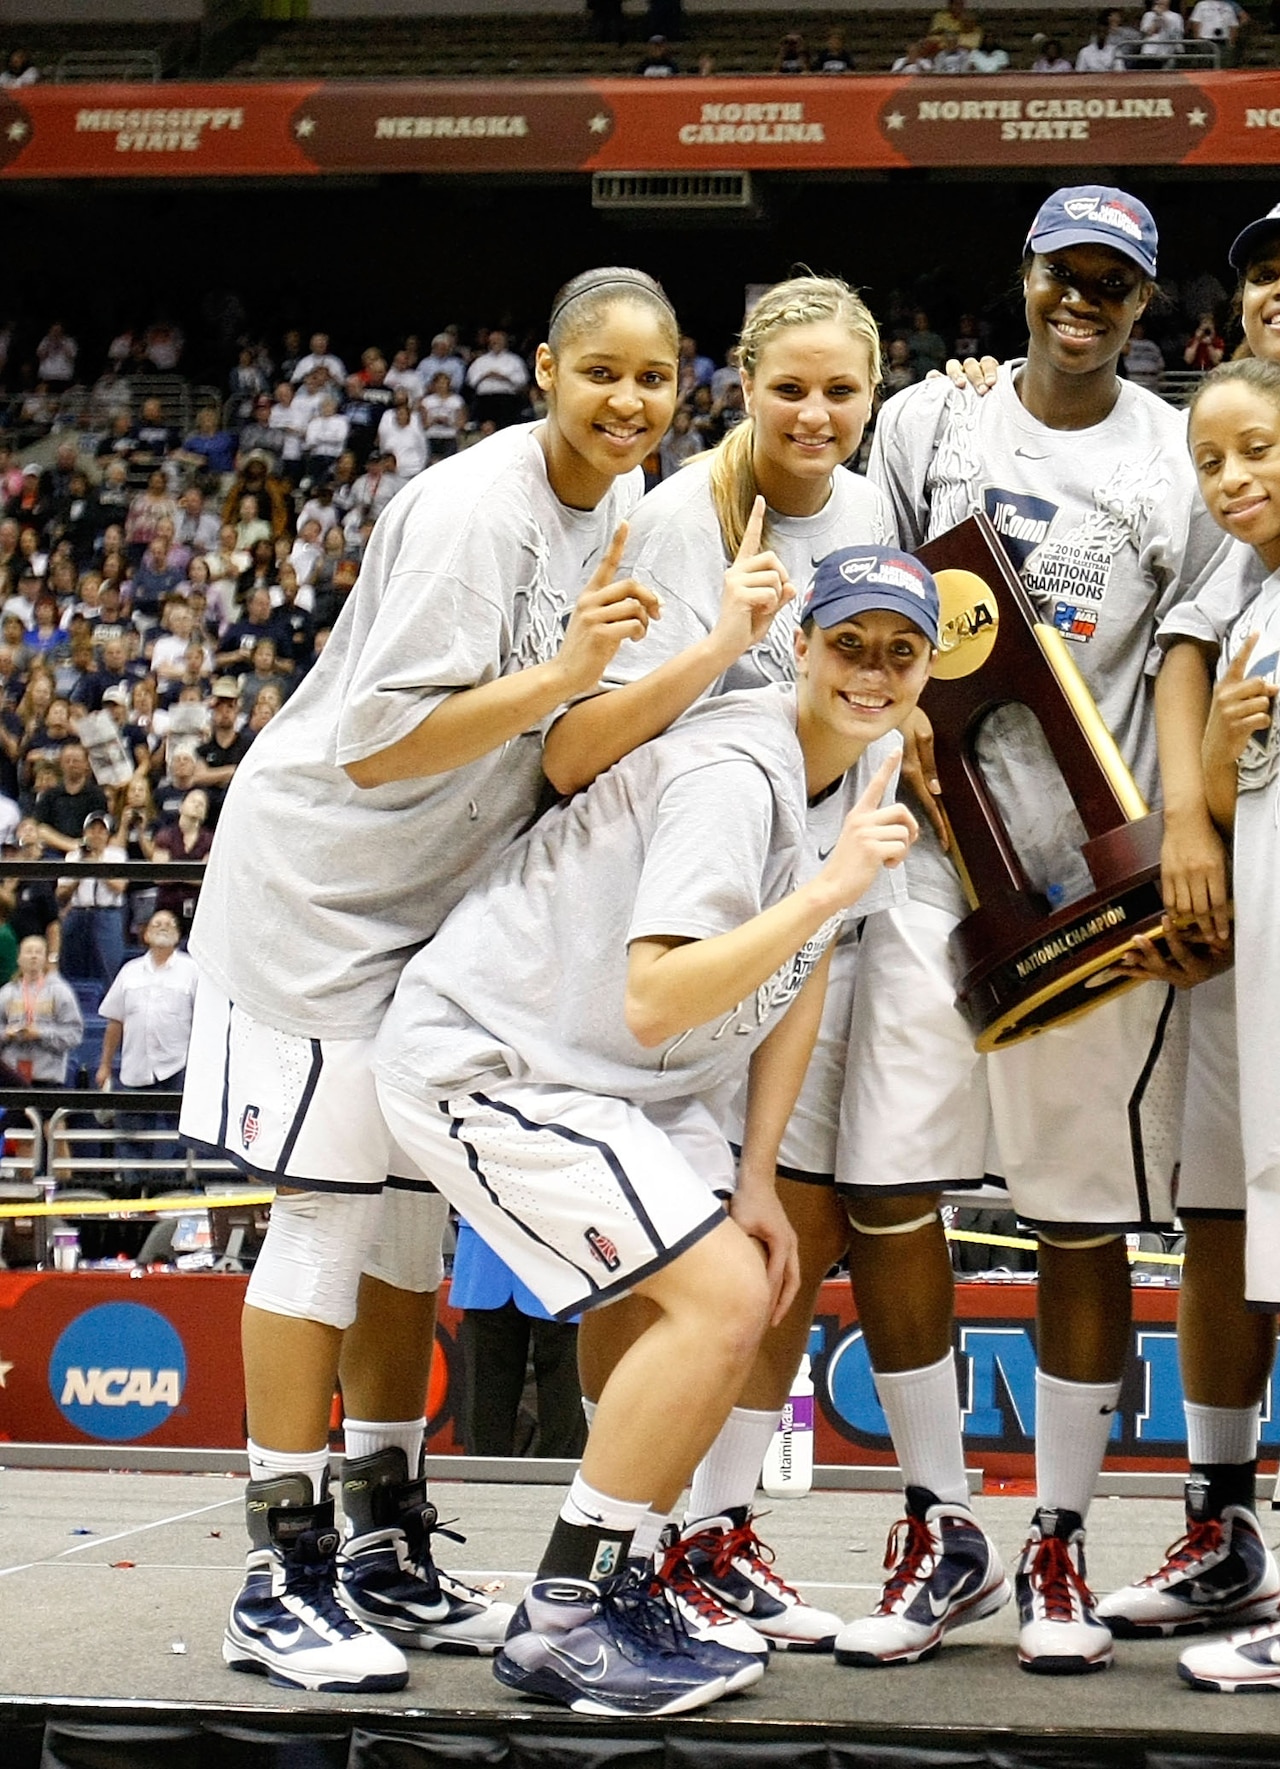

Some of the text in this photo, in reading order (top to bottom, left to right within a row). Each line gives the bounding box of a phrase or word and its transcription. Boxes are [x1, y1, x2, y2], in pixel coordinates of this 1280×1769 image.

[75, 107, 244, 132] MISSISSIPPI
[700, 102, 806, 124] NORTH
[918, 98, 1175, 122] NORTH CAROLINA
[374, 115, 528, 139] NEBRASKA
[677, 123, 826, 145] CAROLINA
[1001, 120, 1090, 141] STATE
[114, 130, 200, 153] STATE
[992, 501, 1049, 544] UConn
[1055, 544, 1111, 566] 2010 NCAA
[1039, 560, 1106, 587] NATIONAL
[1027, 573, 1104, 601] CHAMPIONS
[1015, 905, 1128, 979] NATIONAL CHAMPION
[60, 1367, 181, 1408] NCAA
